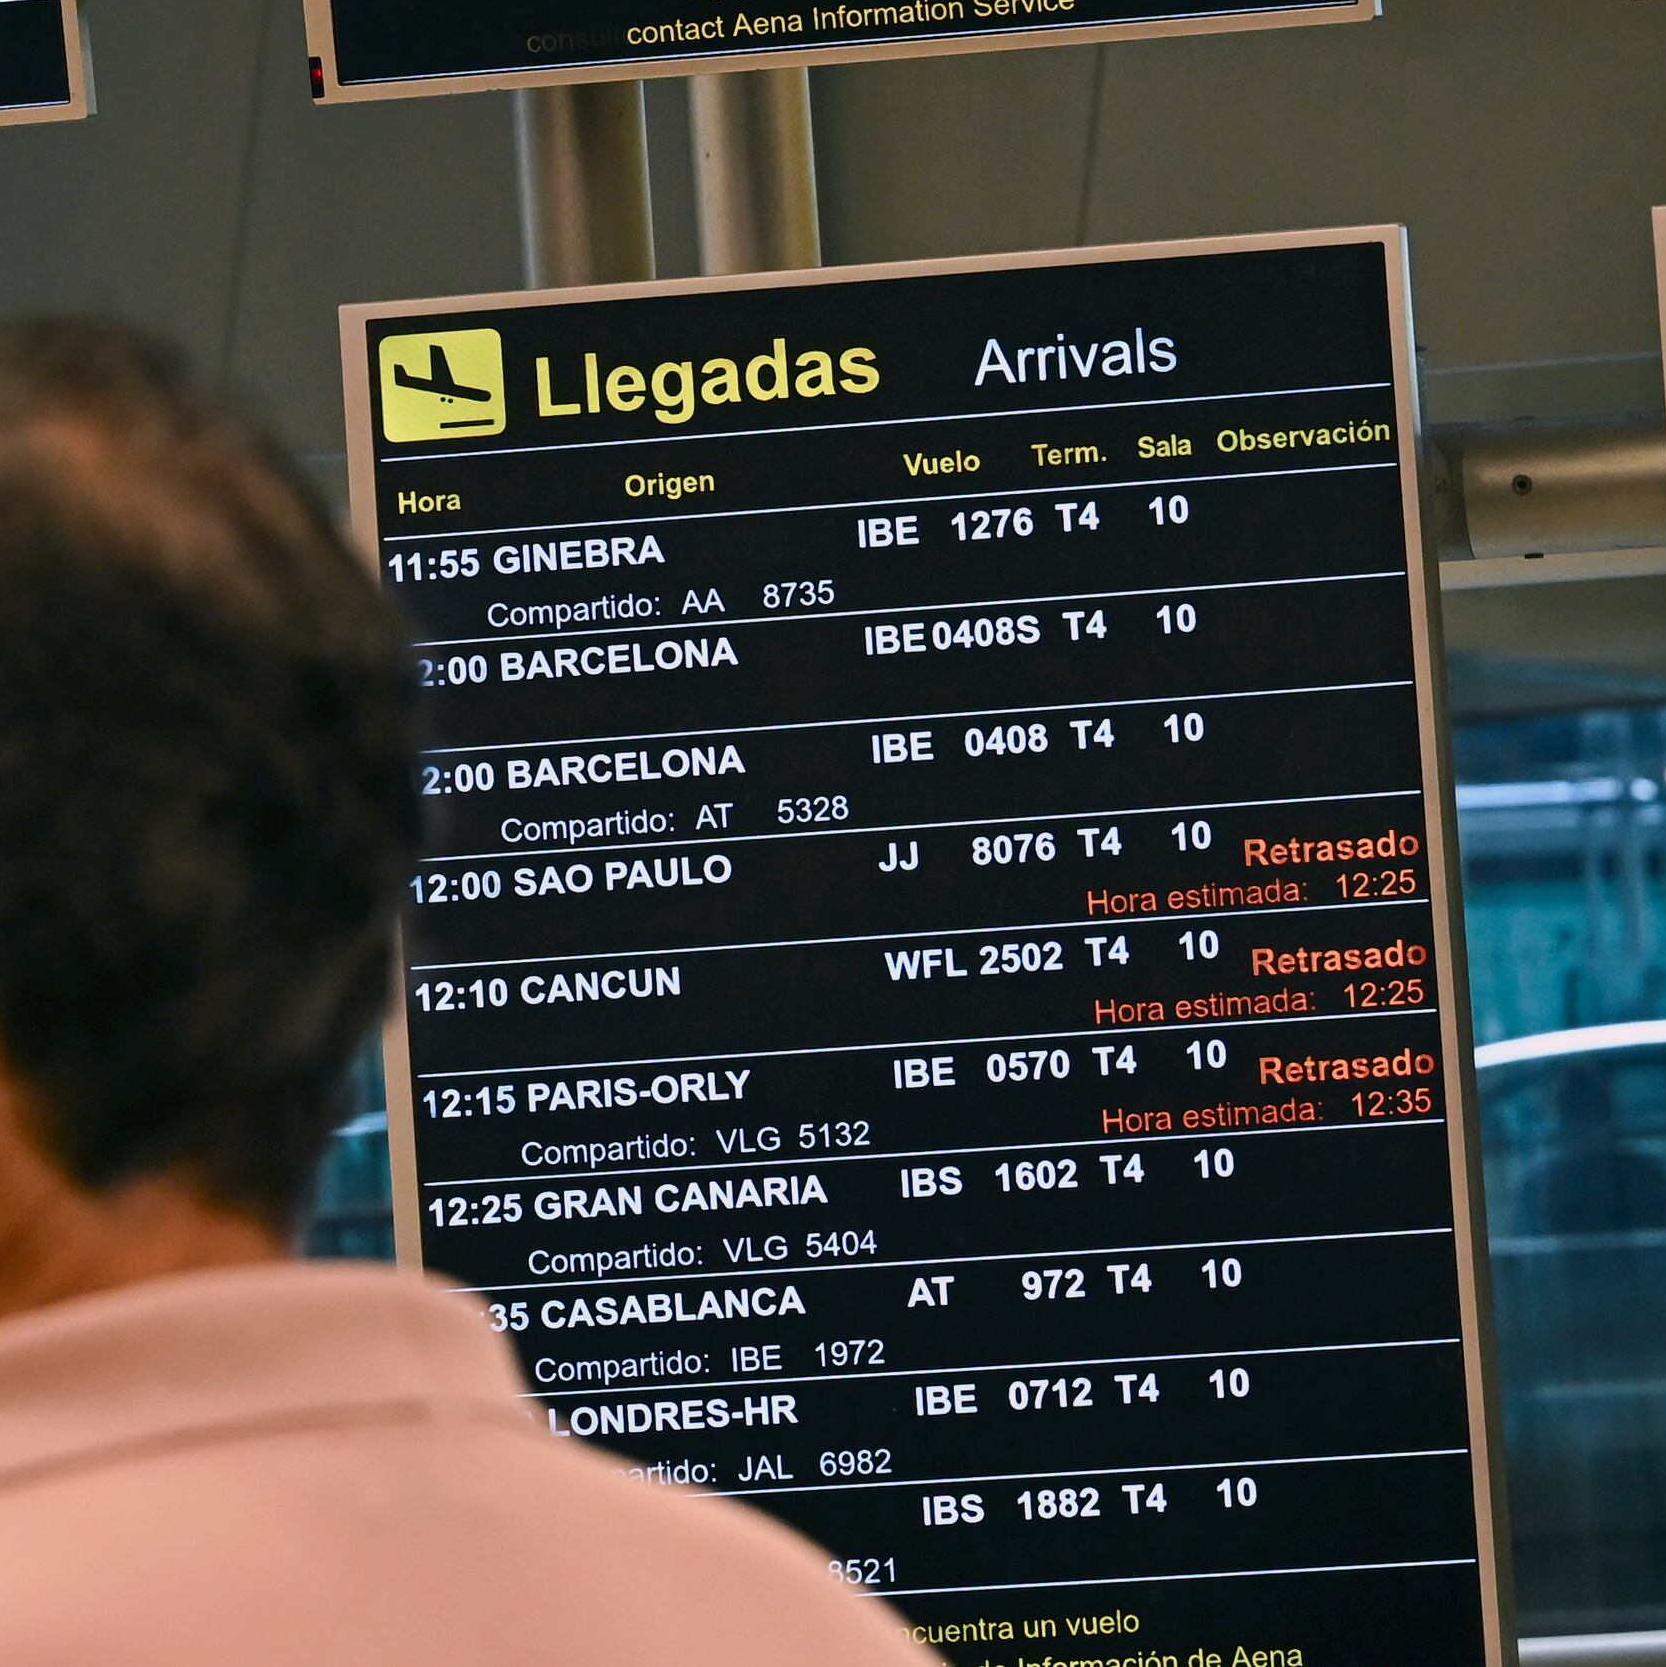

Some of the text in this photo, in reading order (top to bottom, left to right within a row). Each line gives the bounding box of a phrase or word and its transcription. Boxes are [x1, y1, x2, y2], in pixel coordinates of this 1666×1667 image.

[535, 337, 880, 425] Llegadas
[974, 327, 1177, 387] Arrivals
[388, 494, 1189, 583] 11:55 GINEBRA IBE 1276 T4 10
[487, 579, 835, 630] Compartido: AA 8735
[415, 929, 1428, 1012] 12:10 CANCUN WFL 2502 T4 10 Retrasado
[1094, 978, 1424, 1025] Hora estimada: 12:25
